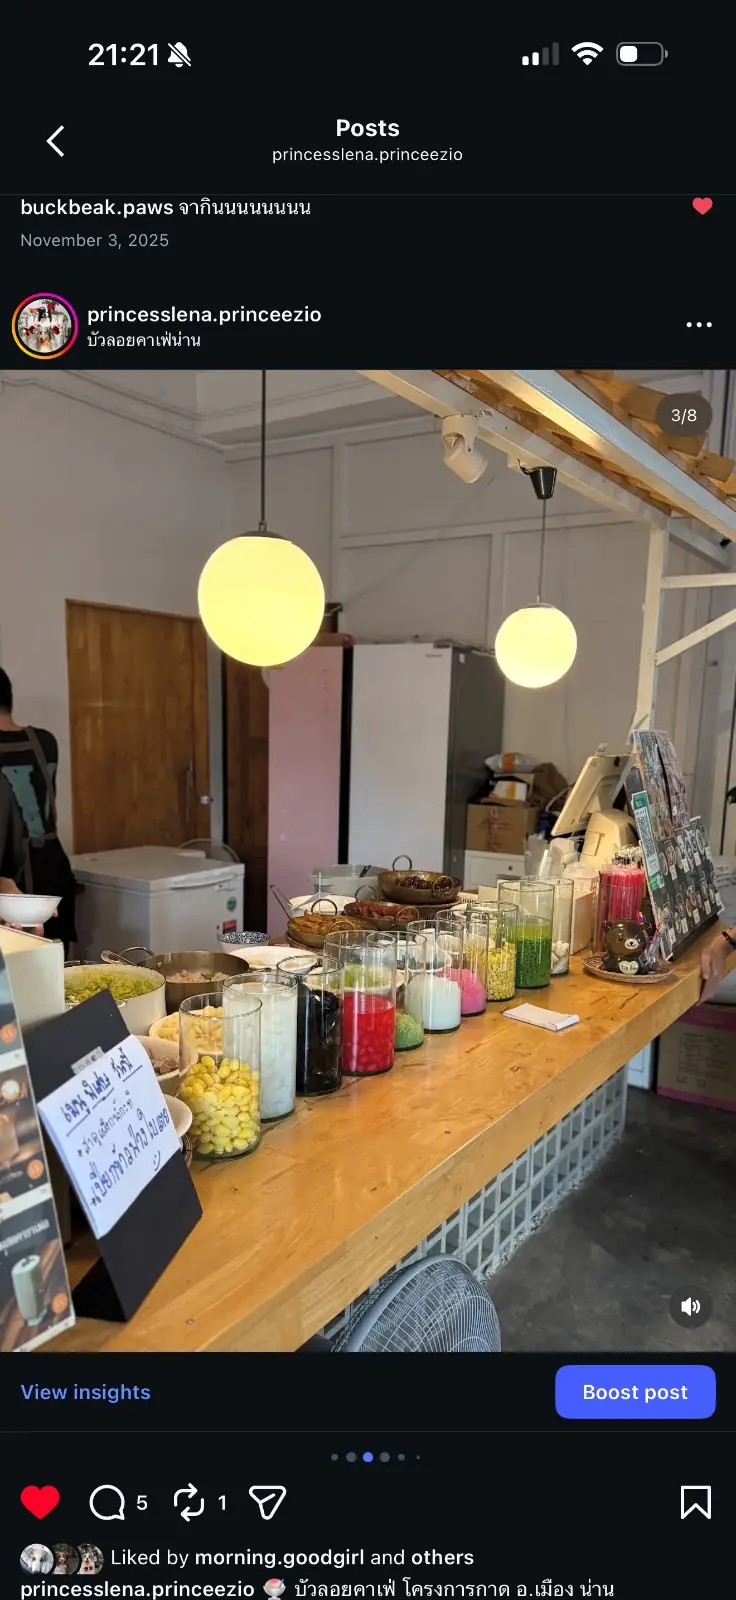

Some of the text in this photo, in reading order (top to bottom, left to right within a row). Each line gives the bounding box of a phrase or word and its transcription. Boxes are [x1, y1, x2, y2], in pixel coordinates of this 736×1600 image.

[88, 42, 158, 67] 21:21
[336, 118, 400, 138] Posts
[272, 147, 463, 165] princesslena.princeezio
[20, 197, 312, 219] buckbeak.paws จากินนนนนนนน
[20, 233, 169, 250] November 3, 2025
[87, 304, 322, 326] princesslena.princeezio
[86, 331, 201, 348] บัวลอยคาเฟ่น่าน
[20, 1383, 152, 1404] View insights
[582, 1383, 689, 1404] Boost post
[136, 1494, 148, 1511] 5
[217, 1494, 226, 1511] 1
[111, 1548, 475, 1569] Liked by morning.goodgirl and others
[20, 1576, 615, 1600] princesslena.princeezio บัวลอยคาเฟ่ โครงการกาด อ.เมือง น่าน
